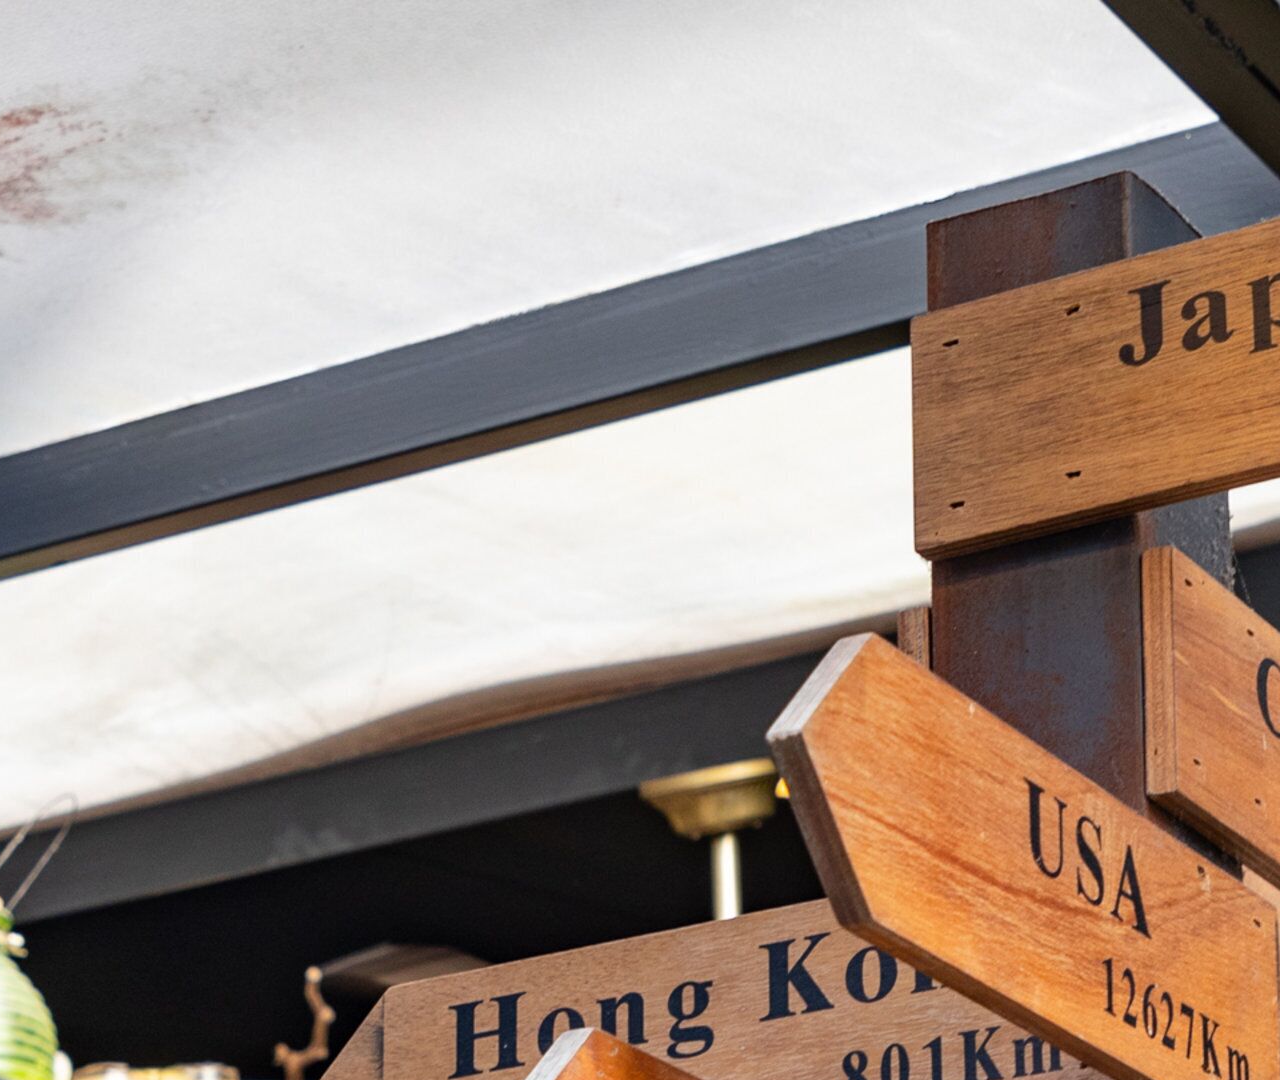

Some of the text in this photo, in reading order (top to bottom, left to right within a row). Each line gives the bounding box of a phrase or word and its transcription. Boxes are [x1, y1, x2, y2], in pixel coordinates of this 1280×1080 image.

[1022, 778, 1152, 940] USA
[447, 931, 950, 1080] Hong Ko
